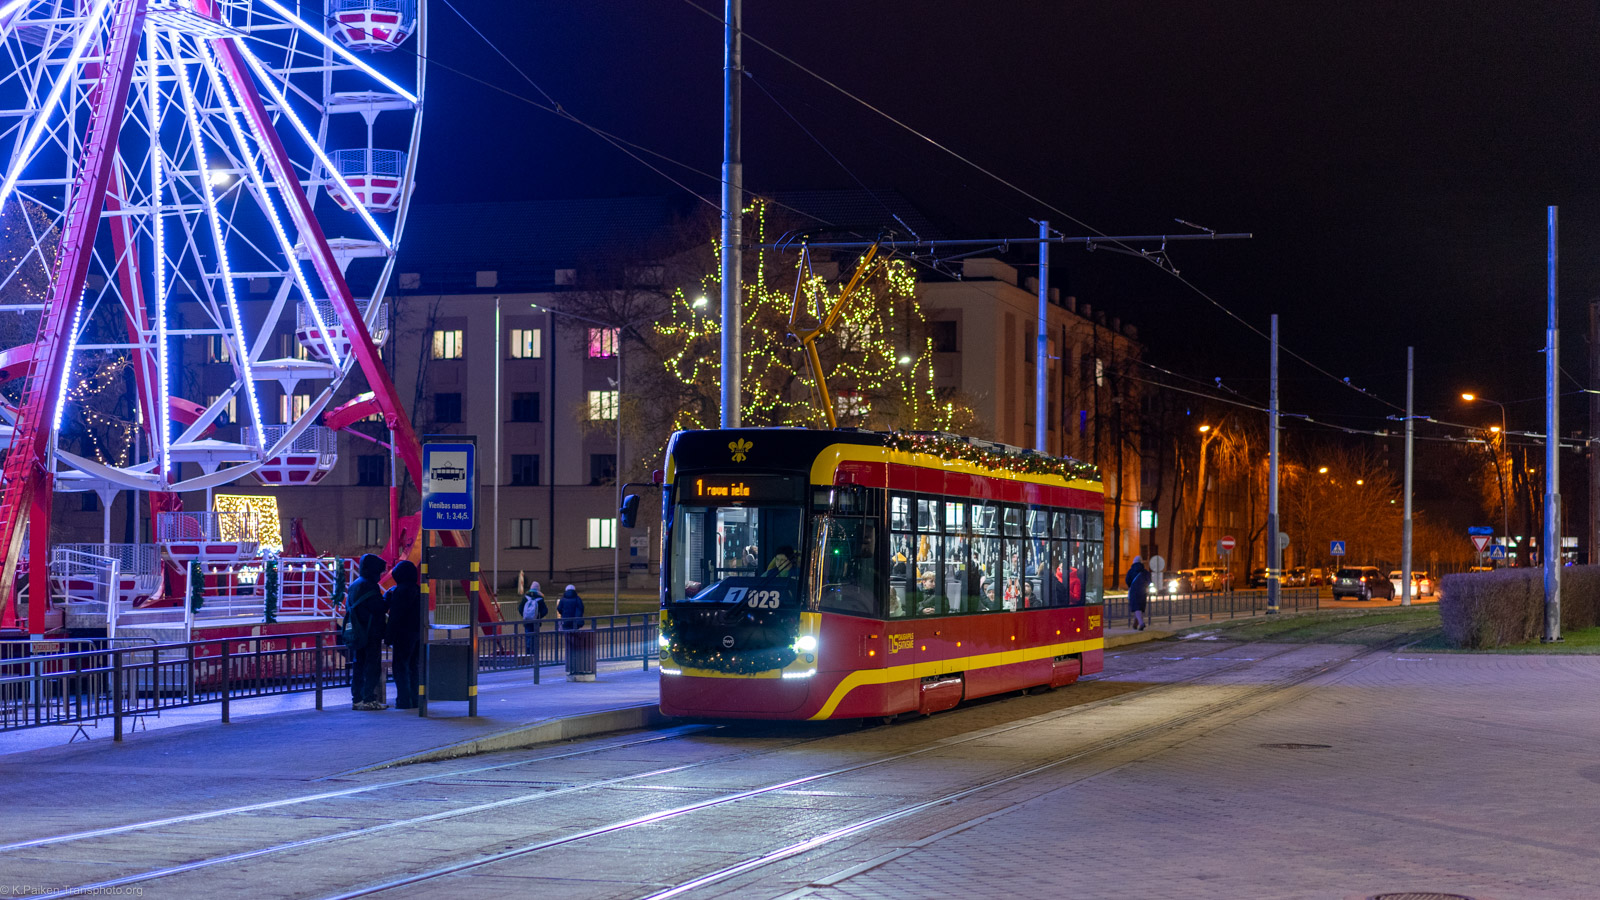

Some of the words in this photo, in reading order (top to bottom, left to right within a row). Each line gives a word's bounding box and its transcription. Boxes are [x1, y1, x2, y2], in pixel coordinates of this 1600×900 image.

[696, 478, 703, 496] 1
[731, 482, 750, 497] iela
[436, 511, 445, 520] Nr.
[731, 589, 742, 602] 1
[747, 589, 780, 609] 023
